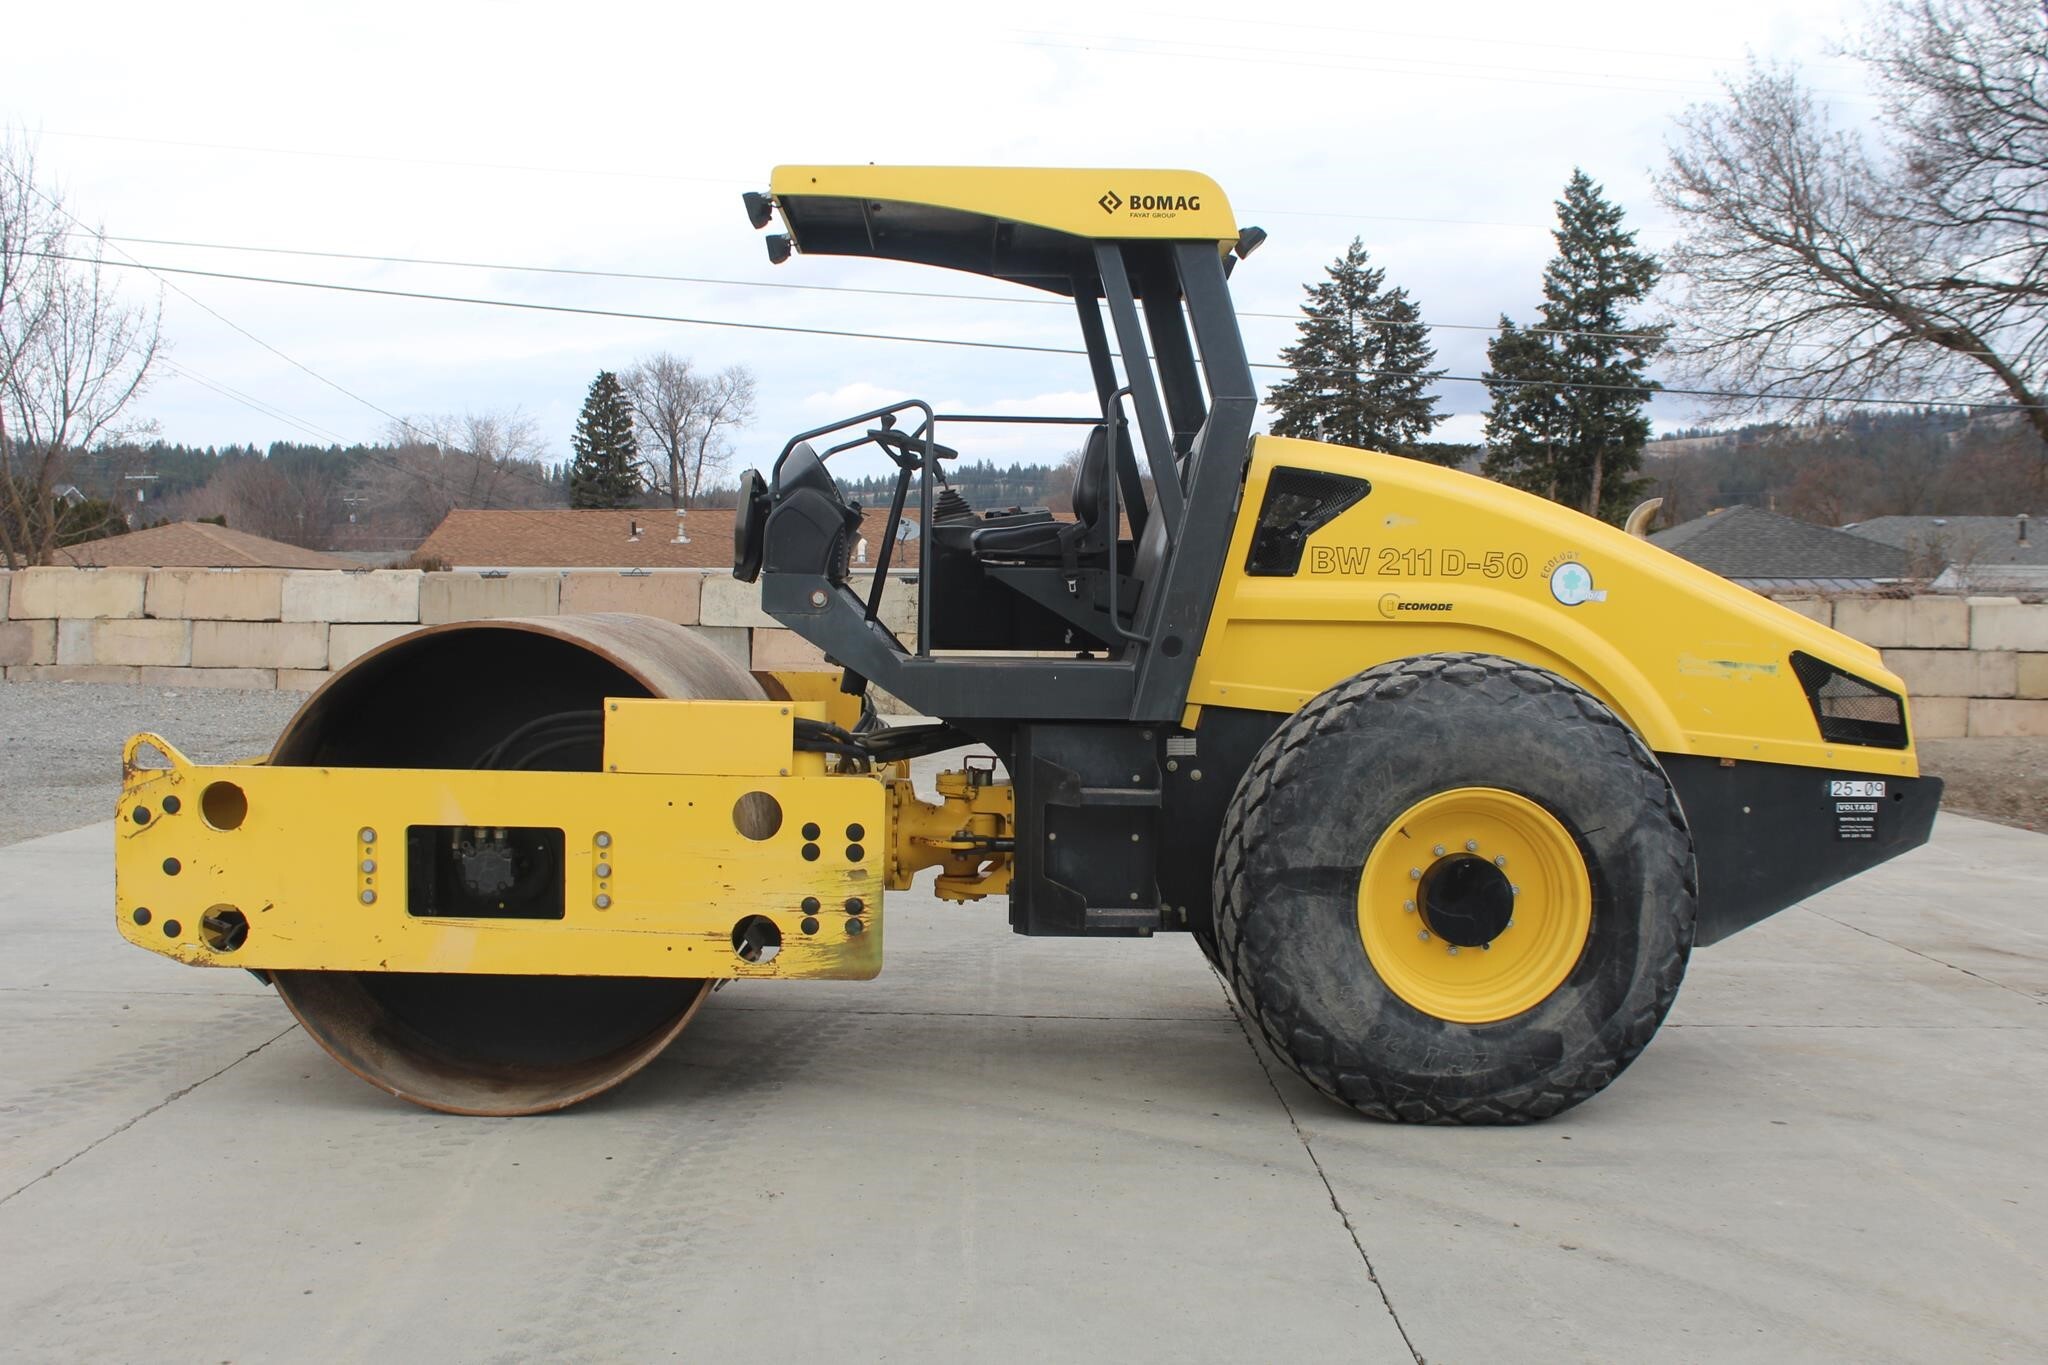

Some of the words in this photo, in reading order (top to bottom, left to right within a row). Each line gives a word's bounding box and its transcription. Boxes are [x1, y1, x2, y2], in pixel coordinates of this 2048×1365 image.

[1129, 195, 1201, 211] BOMAG
[1310, 546, 1370, 575] BW
[1377, 548, 1432, 577] 211
[1440, 549, 1528, 579] D-50
[1397, 602, 1454, 612] ECOMODE
[1832, 781, 1884, 796] 25-09
